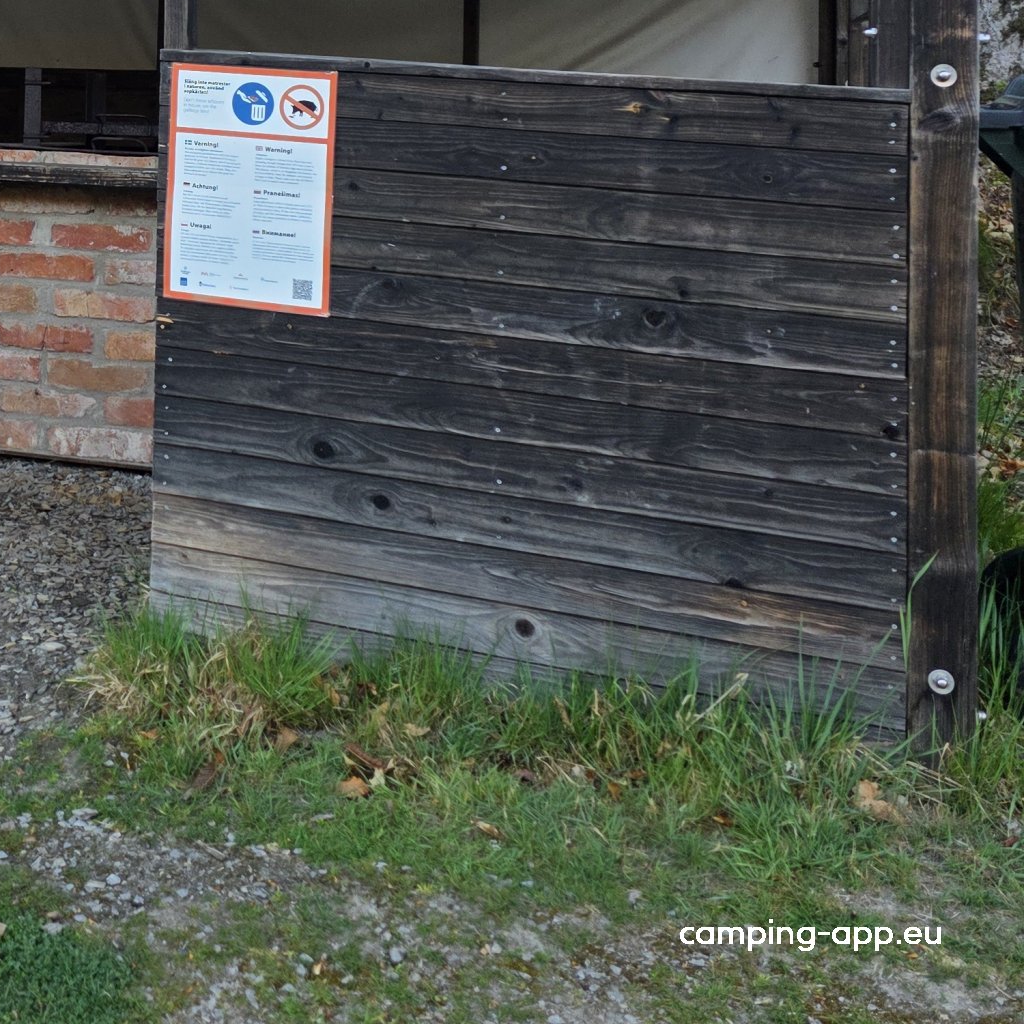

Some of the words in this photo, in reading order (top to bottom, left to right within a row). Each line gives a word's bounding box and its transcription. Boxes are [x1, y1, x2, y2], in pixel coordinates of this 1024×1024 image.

[194, 140, 219, 148] Varning!
[265, 146, 293, 154] Warning!
[192, 182, 219, 191] Achtung!
[189, 222, 212, 230] Uwaga!
